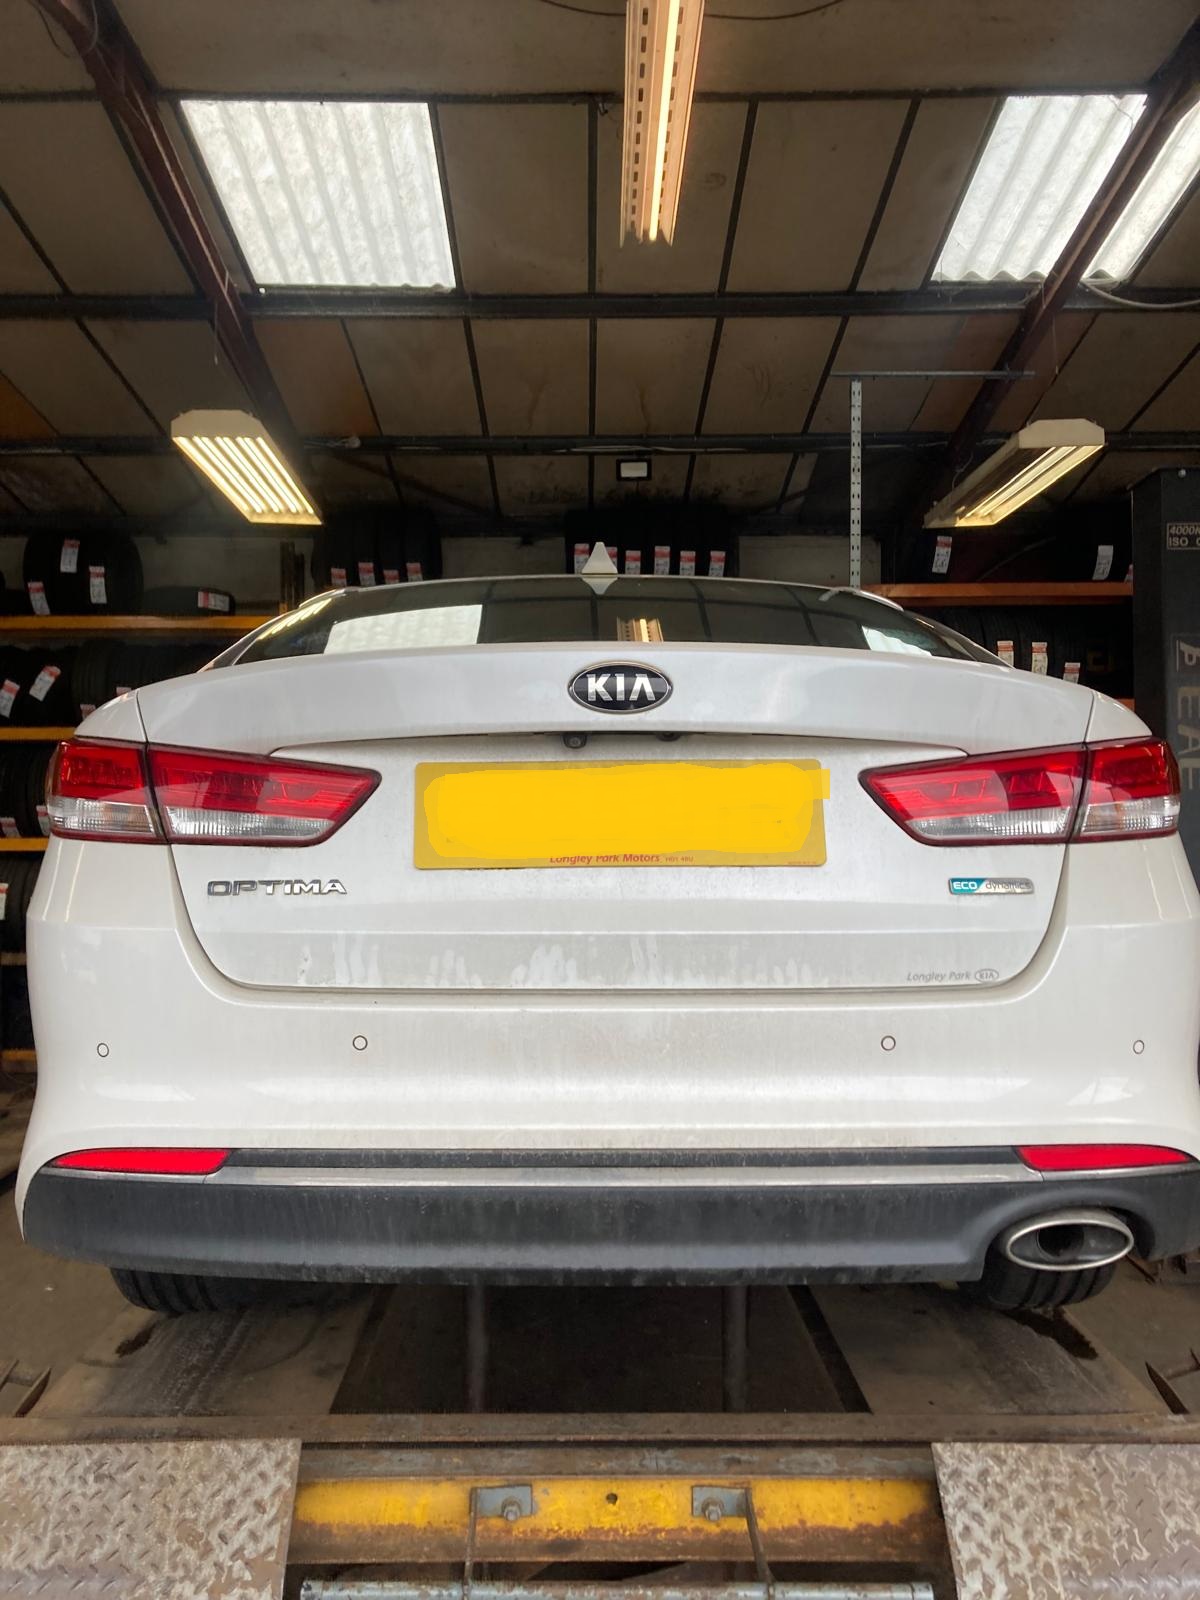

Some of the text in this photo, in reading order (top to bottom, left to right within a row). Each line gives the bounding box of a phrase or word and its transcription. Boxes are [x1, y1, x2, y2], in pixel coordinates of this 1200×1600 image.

[1169, 537, 1188, 547] ISO
[586, 673, 656, 702] KIA
[623, 853, 660, 863] Motors
[207, 879, 347, 896] OPTIMA
[907, 971, 946, 983] Longley
[949, 971, 972, 981] Park
